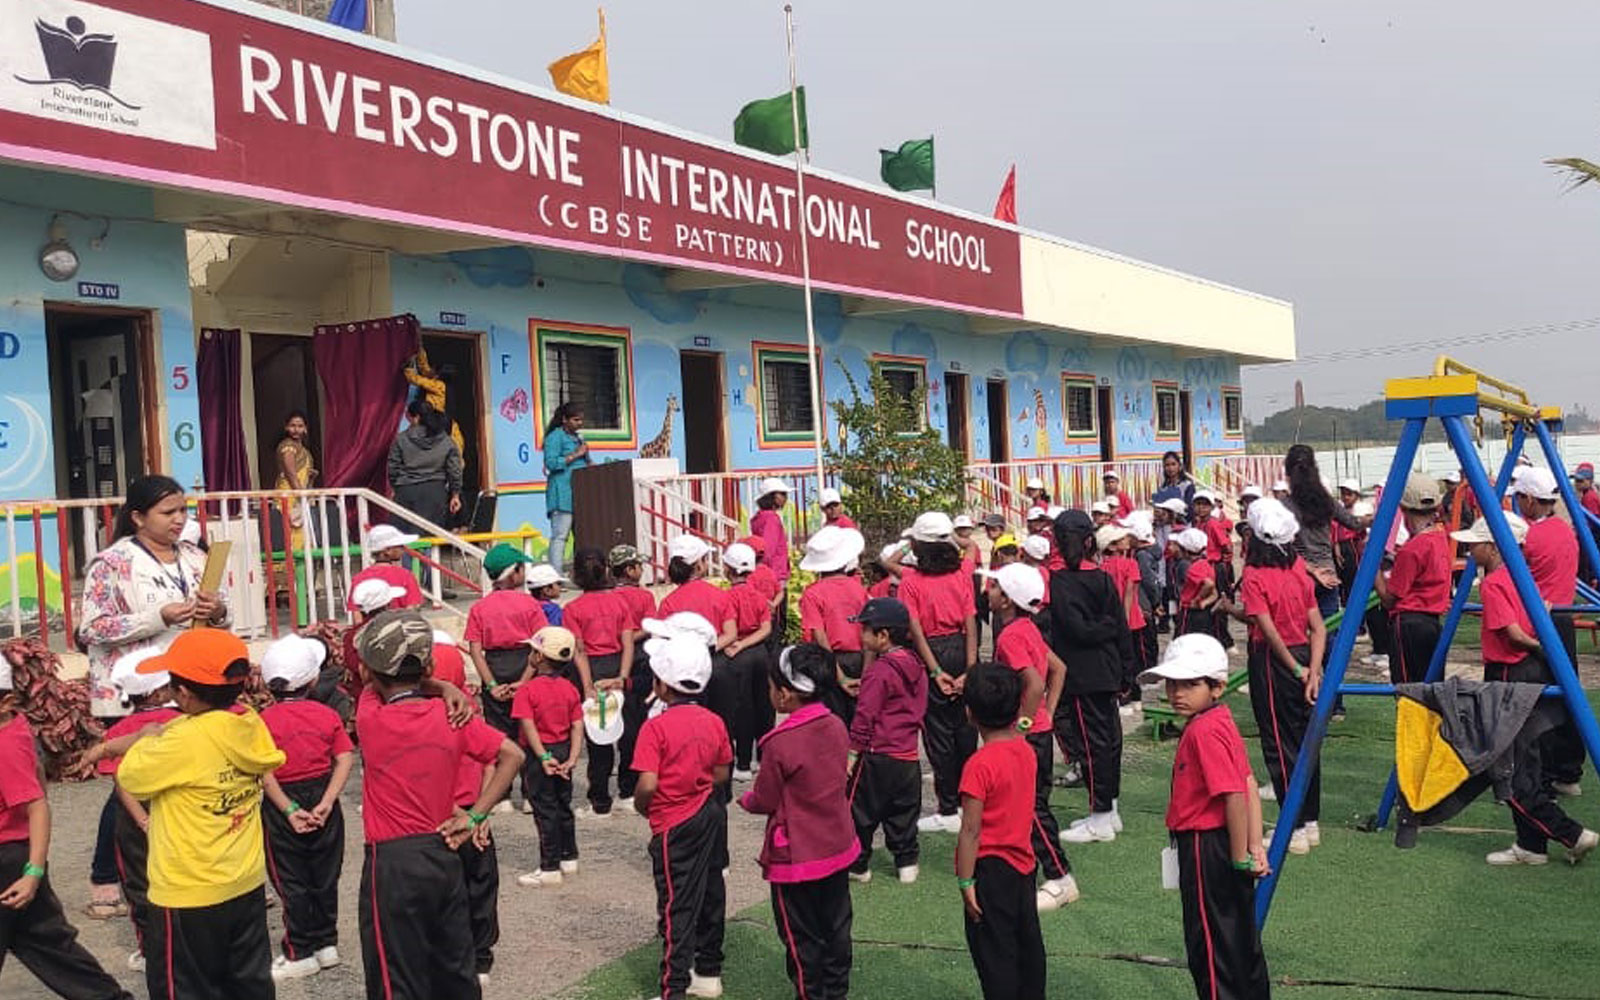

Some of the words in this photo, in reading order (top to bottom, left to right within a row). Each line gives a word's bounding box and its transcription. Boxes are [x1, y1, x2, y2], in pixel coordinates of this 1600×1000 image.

[240, 44, 584, 187] RIVERSTONE
[621, 145, 881, 250] INTERNATONAL
[905, 219, 992, 274] SCHOOL
[676, 223, 783, 267] PATTERN)
[0, 331, 20, 359] D
[172, 365, 189, 390] 5
[501, 353, 511, 374] F
[174, 421, 195, 452] 6
[518, 443, 529, 464] G
